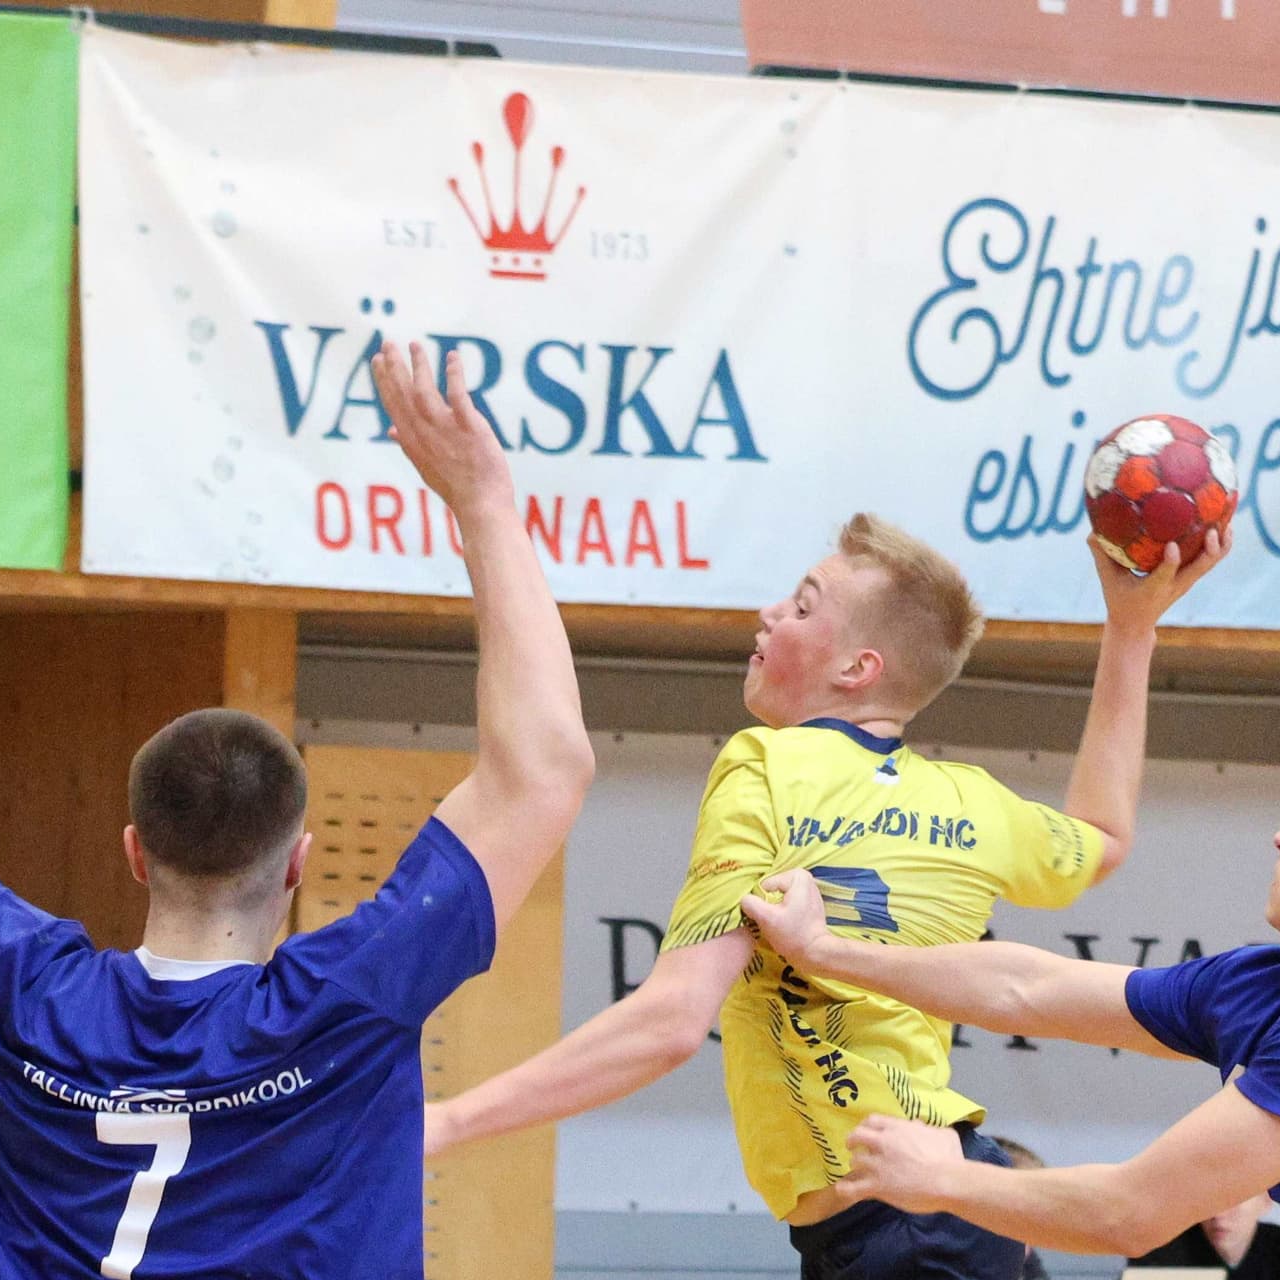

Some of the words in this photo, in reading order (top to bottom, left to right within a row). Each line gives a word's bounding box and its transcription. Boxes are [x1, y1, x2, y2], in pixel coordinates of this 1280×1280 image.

[383, 218, 447, 250] EST.
[590, 229, 650, 262] 1973
[907, 197, 1199, 402] Ehtne
[254, 296, 769, 464] VÄRSKA
[314, 480, 711, 570] ORINAAL
[929, 814, 978, 850] HC
[22, 1060, 132, 1113] TALLINNA
[814, 1049, 859, 1108] HC
